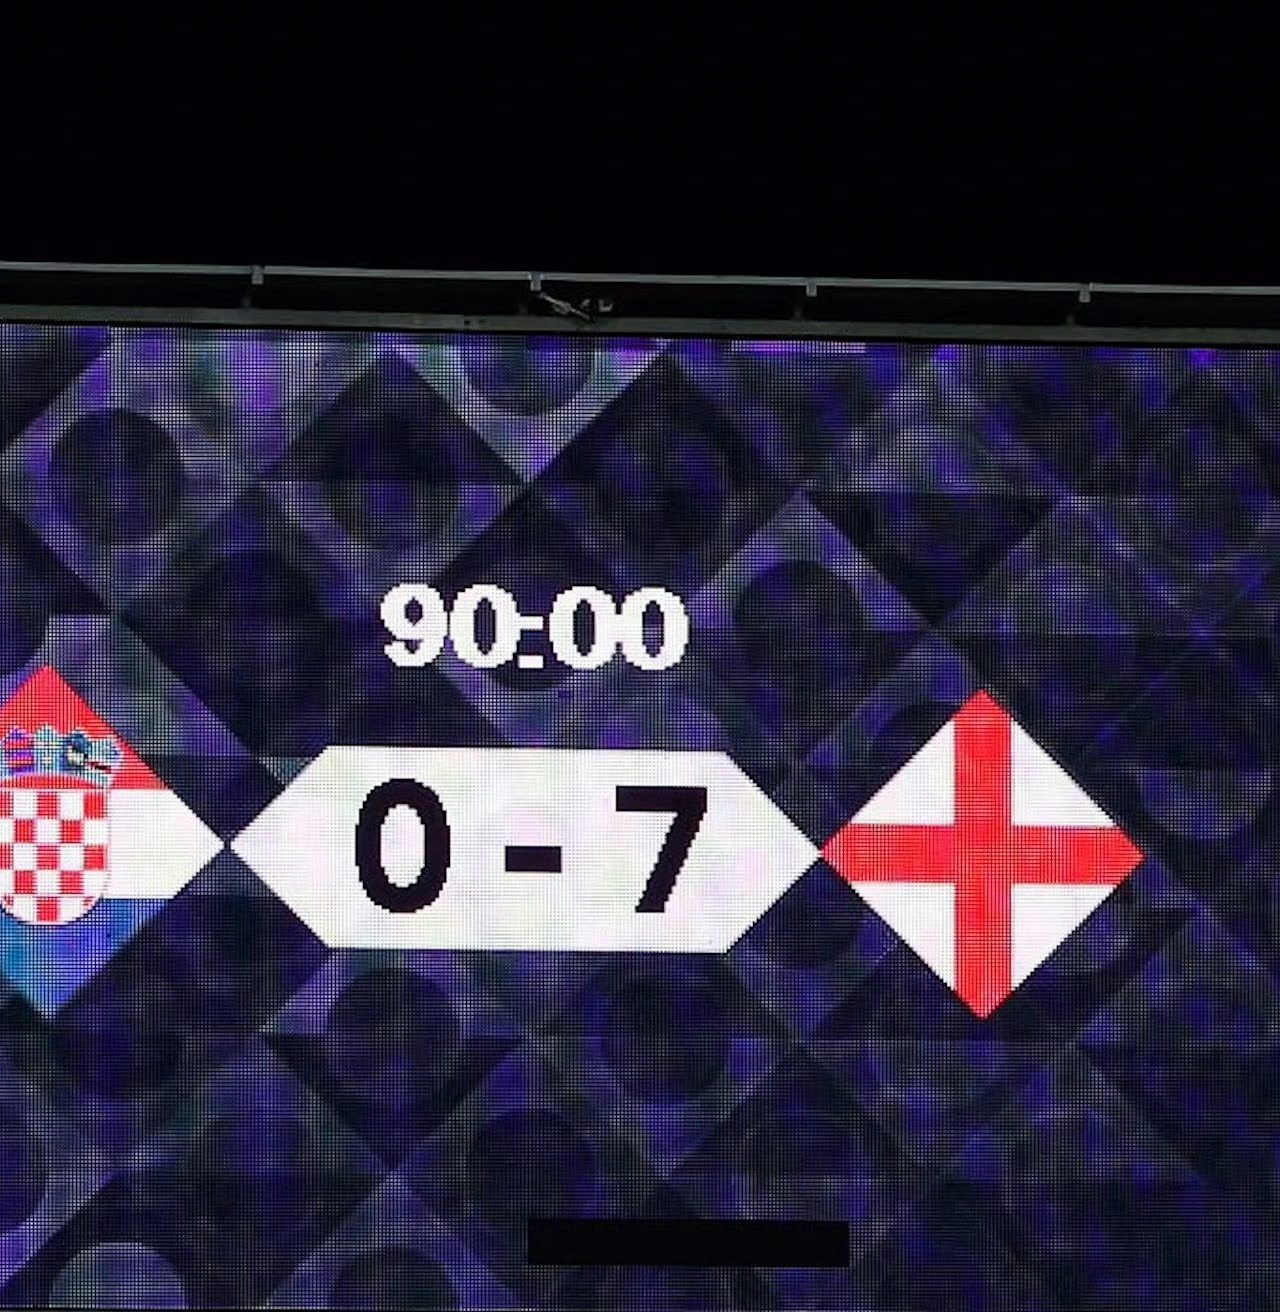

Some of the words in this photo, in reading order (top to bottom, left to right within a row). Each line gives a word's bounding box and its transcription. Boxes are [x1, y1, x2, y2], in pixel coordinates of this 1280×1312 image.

[380, 582, 689, 671] 90:00
[355, 778, 451, 914] 0
[615, 786, 708, 913] 7
